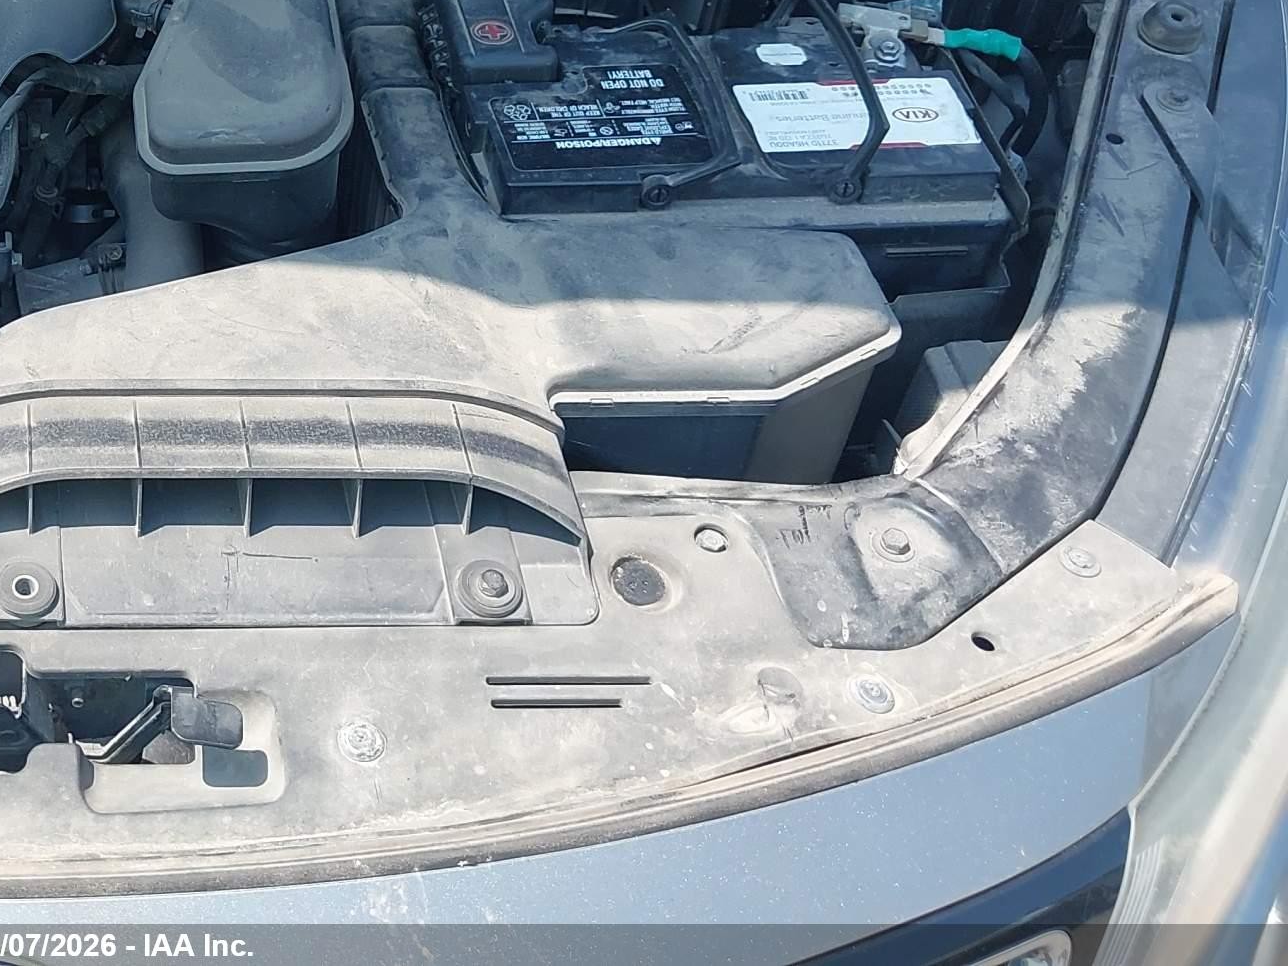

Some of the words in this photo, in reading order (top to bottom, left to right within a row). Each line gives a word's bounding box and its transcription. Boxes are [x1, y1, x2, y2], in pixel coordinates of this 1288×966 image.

[608, 70, 652, 80] BATTERY!
[602, 80, 628, 90] OPEN
[628, 79, 647, 89] NOT
[650, 78, 664, 88] DO
[556, 137, 655, 149] DANGER/POISON
